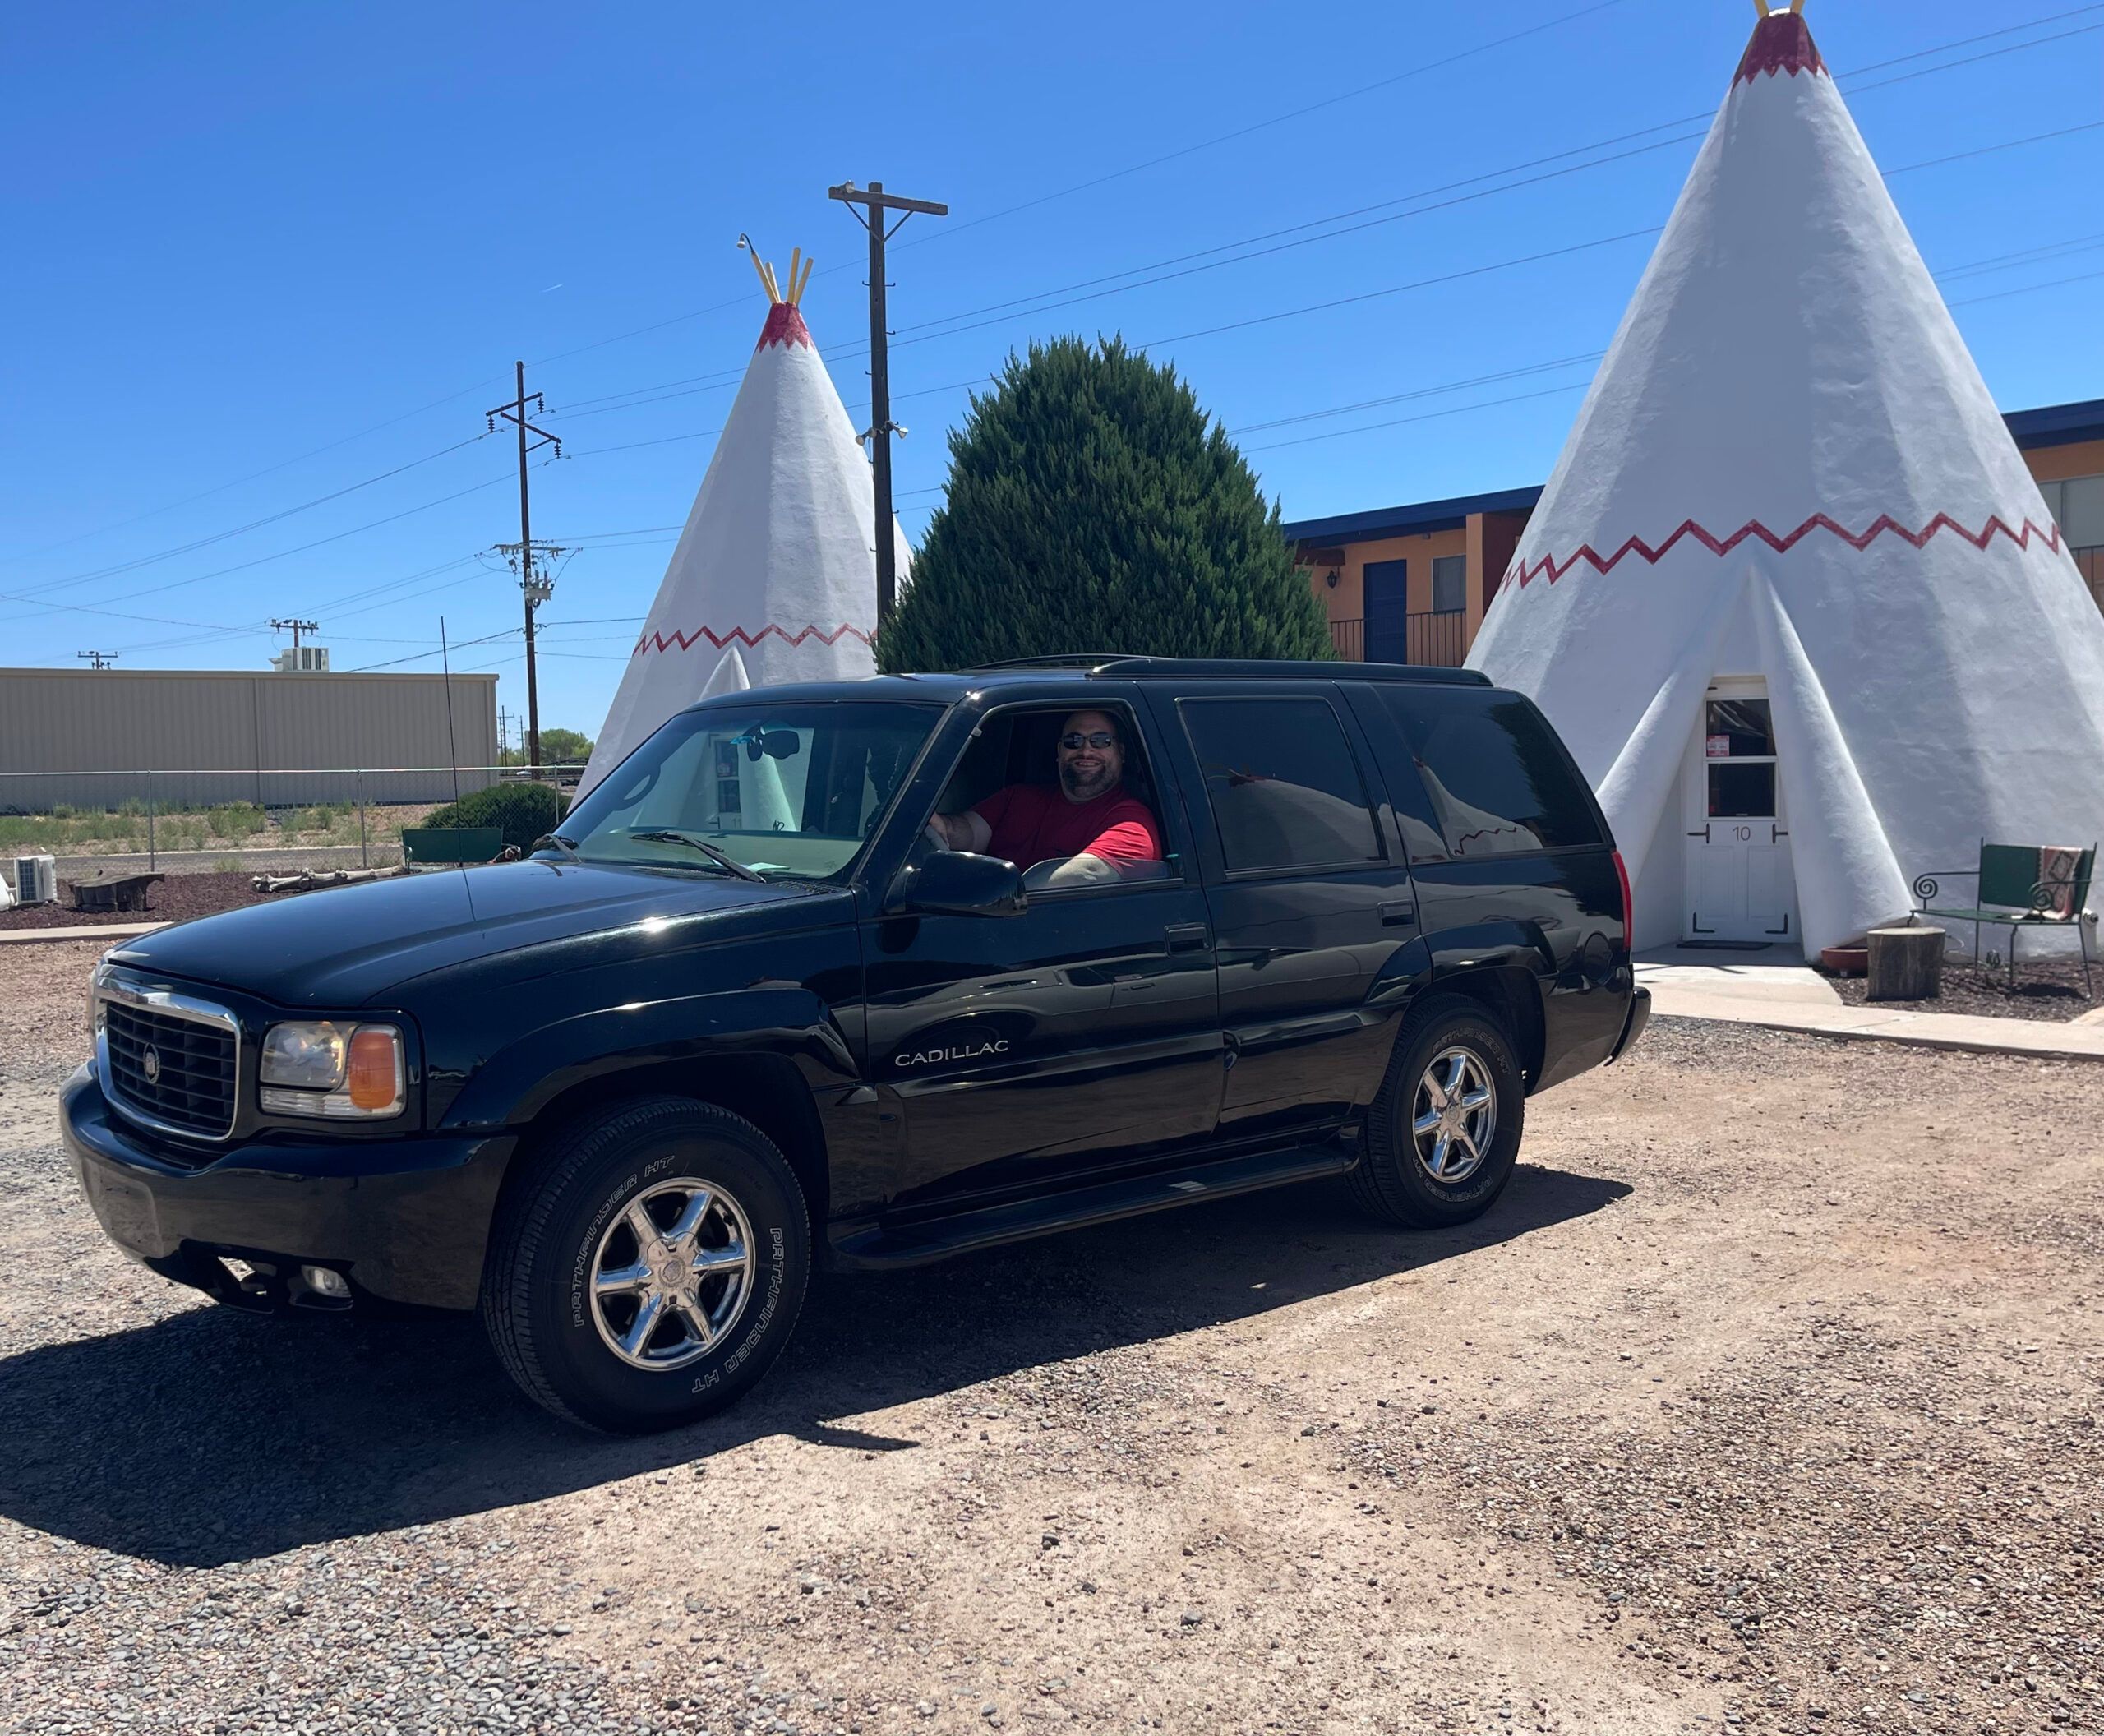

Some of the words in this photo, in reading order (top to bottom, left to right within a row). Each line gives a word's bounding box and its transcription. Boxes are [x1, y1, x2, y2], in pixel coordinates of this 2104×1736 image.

[1732, 826, 1751, 842] 10
[895, 1040, 1009, 1067] CADILLAC
[571, 1175, 636, 1327] PATHFINDER
[644, 1155, 674, 1176] HT
[724, 1227, 784, 1374] PATHFINDER
[691, 1370, 720, 1393] HT
